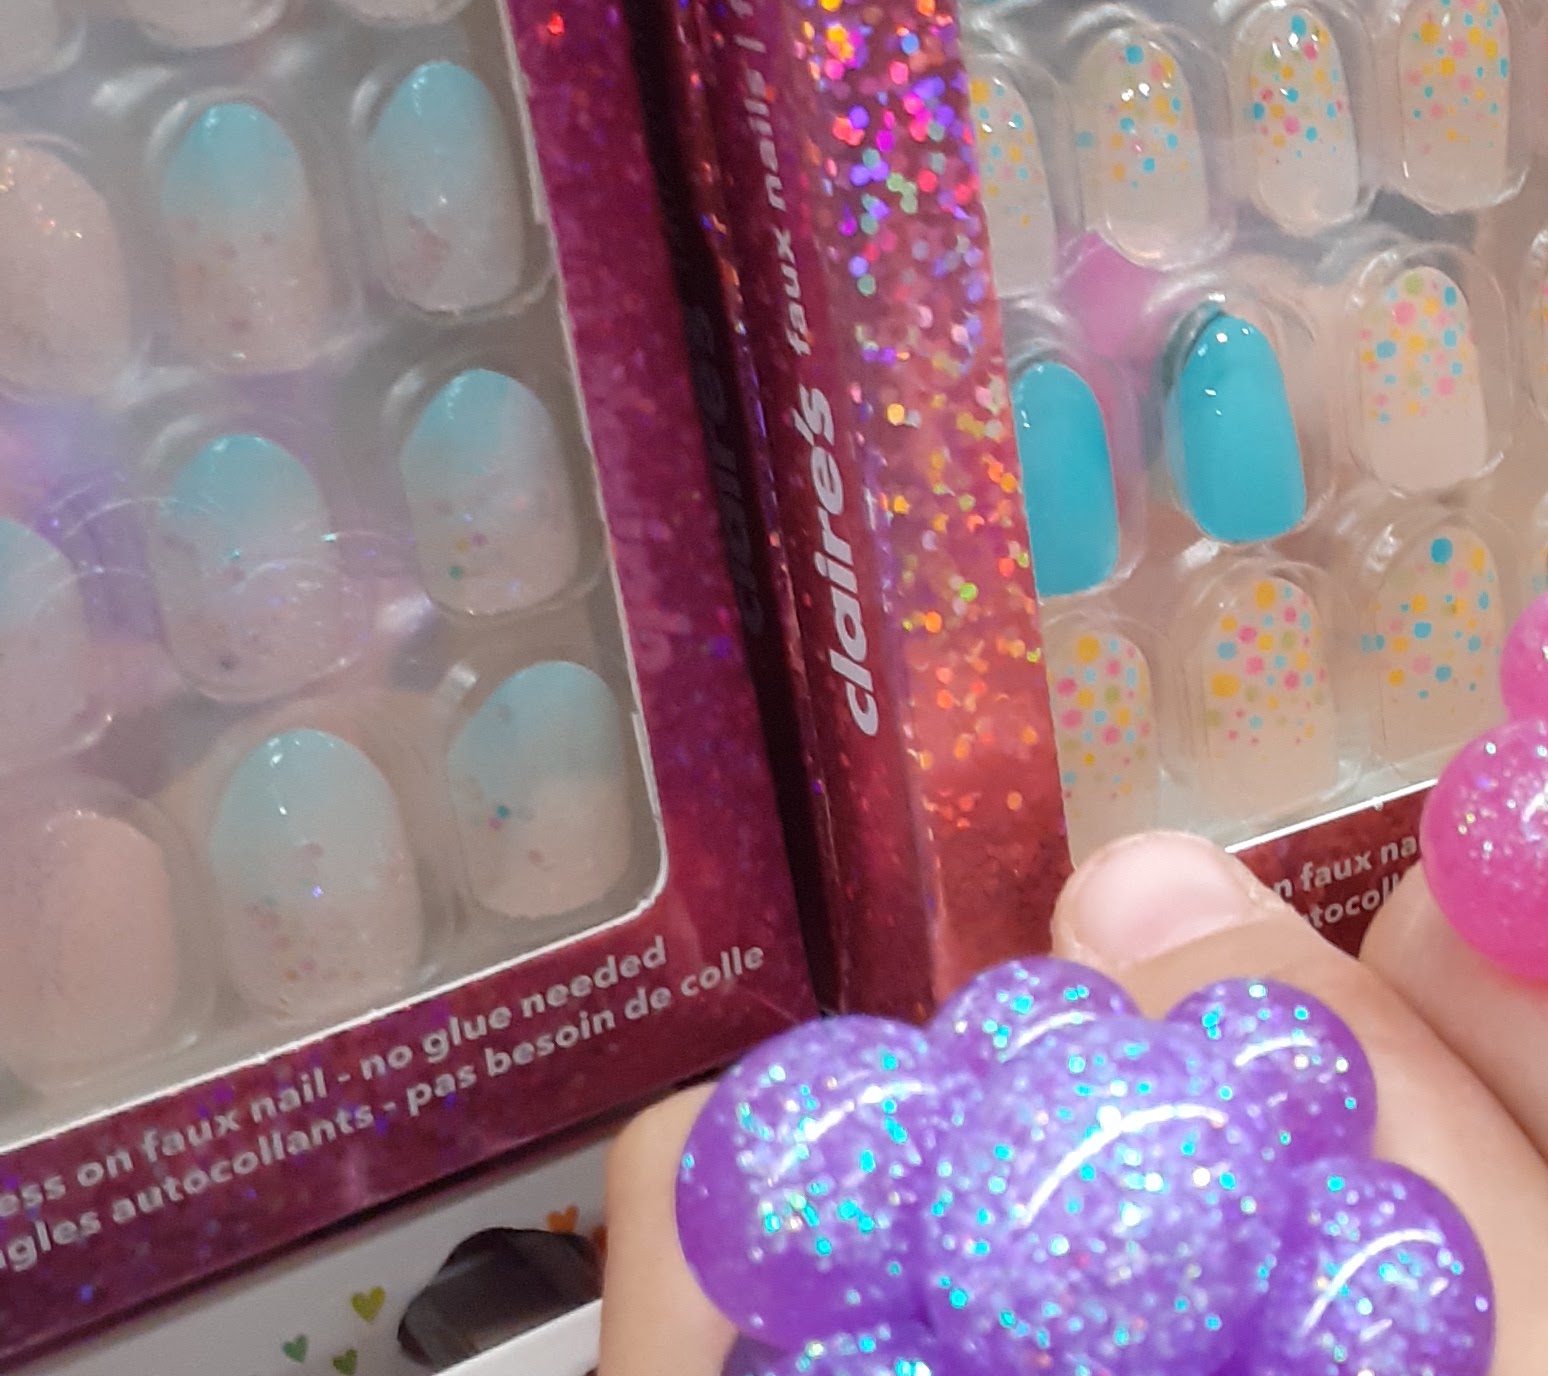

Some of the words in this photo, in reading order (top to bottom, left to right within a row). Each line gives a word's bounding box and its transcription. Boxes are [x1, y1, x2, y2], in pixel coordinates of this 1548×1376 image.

[743, 63, 786, 212] nails
[772, 225, 814, 358] faux
[790, 383, 880, 737] claire's
[1300, 850, 1373, 893] faux
[1380, 835, 1418, 866] na
[0, 1175, 67, 1218] ess
[77, 1147, 134, 1188] on
[141, 1113, 241, 1165] faux
[250, 1066, 329, 1124] nail
[360, 1044, 414, 1081] no
[422, 1005, 513, 1065] glue
[520, 934, 668, 1020] needed
[0, 1210, 102, 1274] gles
[111, 1104, 376, 1225] autocollants
[406, 1064, 478, 1118] pas
[484, 1009, 617, 1078] besoin
[624, 985, 673, 1022] de
[680, 945, 765, 998] colle
